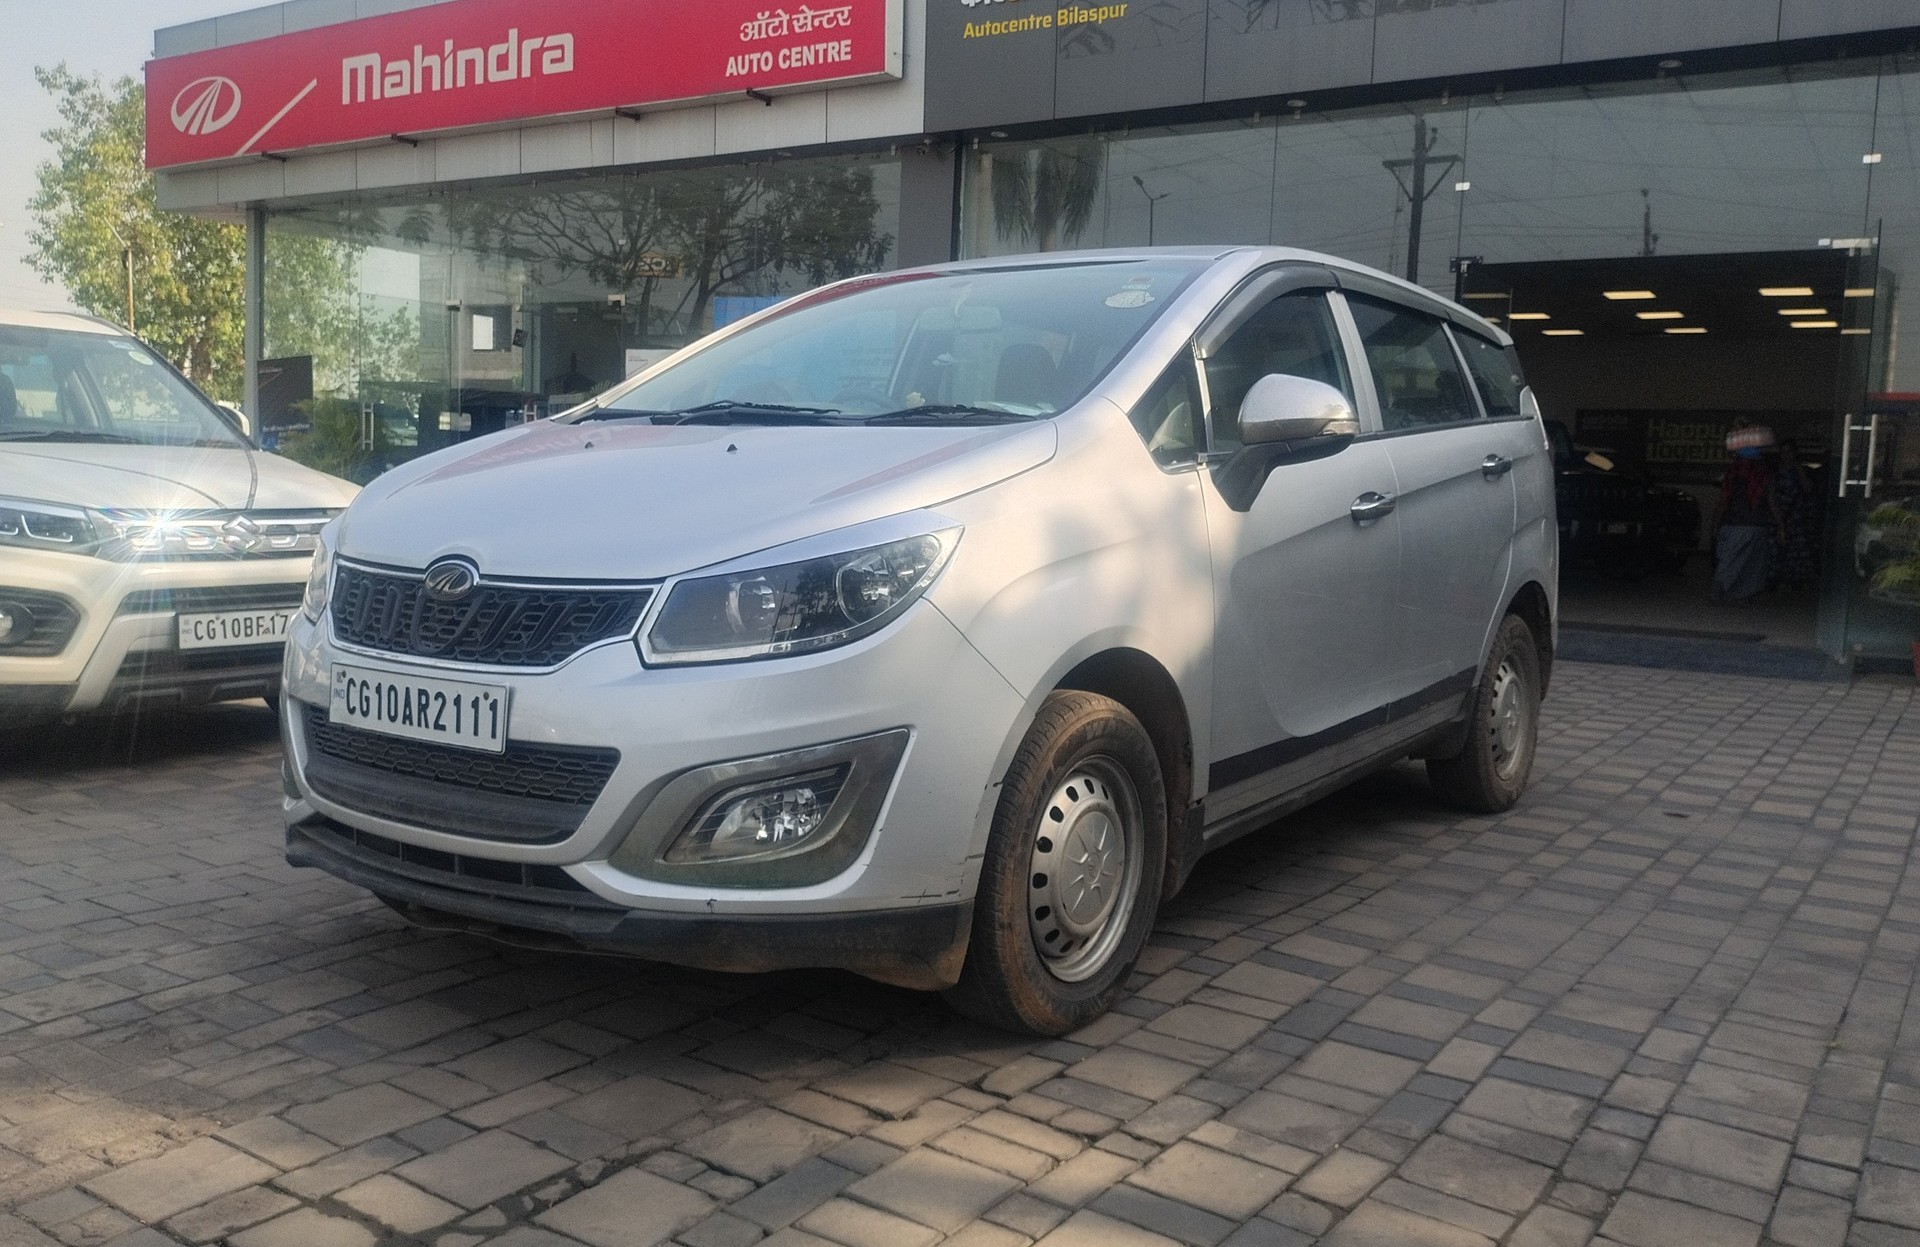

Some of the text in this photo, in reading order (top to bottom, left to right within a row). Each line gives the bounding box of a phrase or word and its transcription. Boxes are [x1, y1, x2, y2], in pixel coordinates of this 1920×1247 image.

[740, 4, 852, 41] ऑटो सेन्टर
[963, 3, 1128, 39] Autocentre Bilaspur
[341, 28, 574, 105] Mahindra
[725, 39, 852, 77] AUTO CENTRE
[346, 677, 498, 739] CG10AR2111
